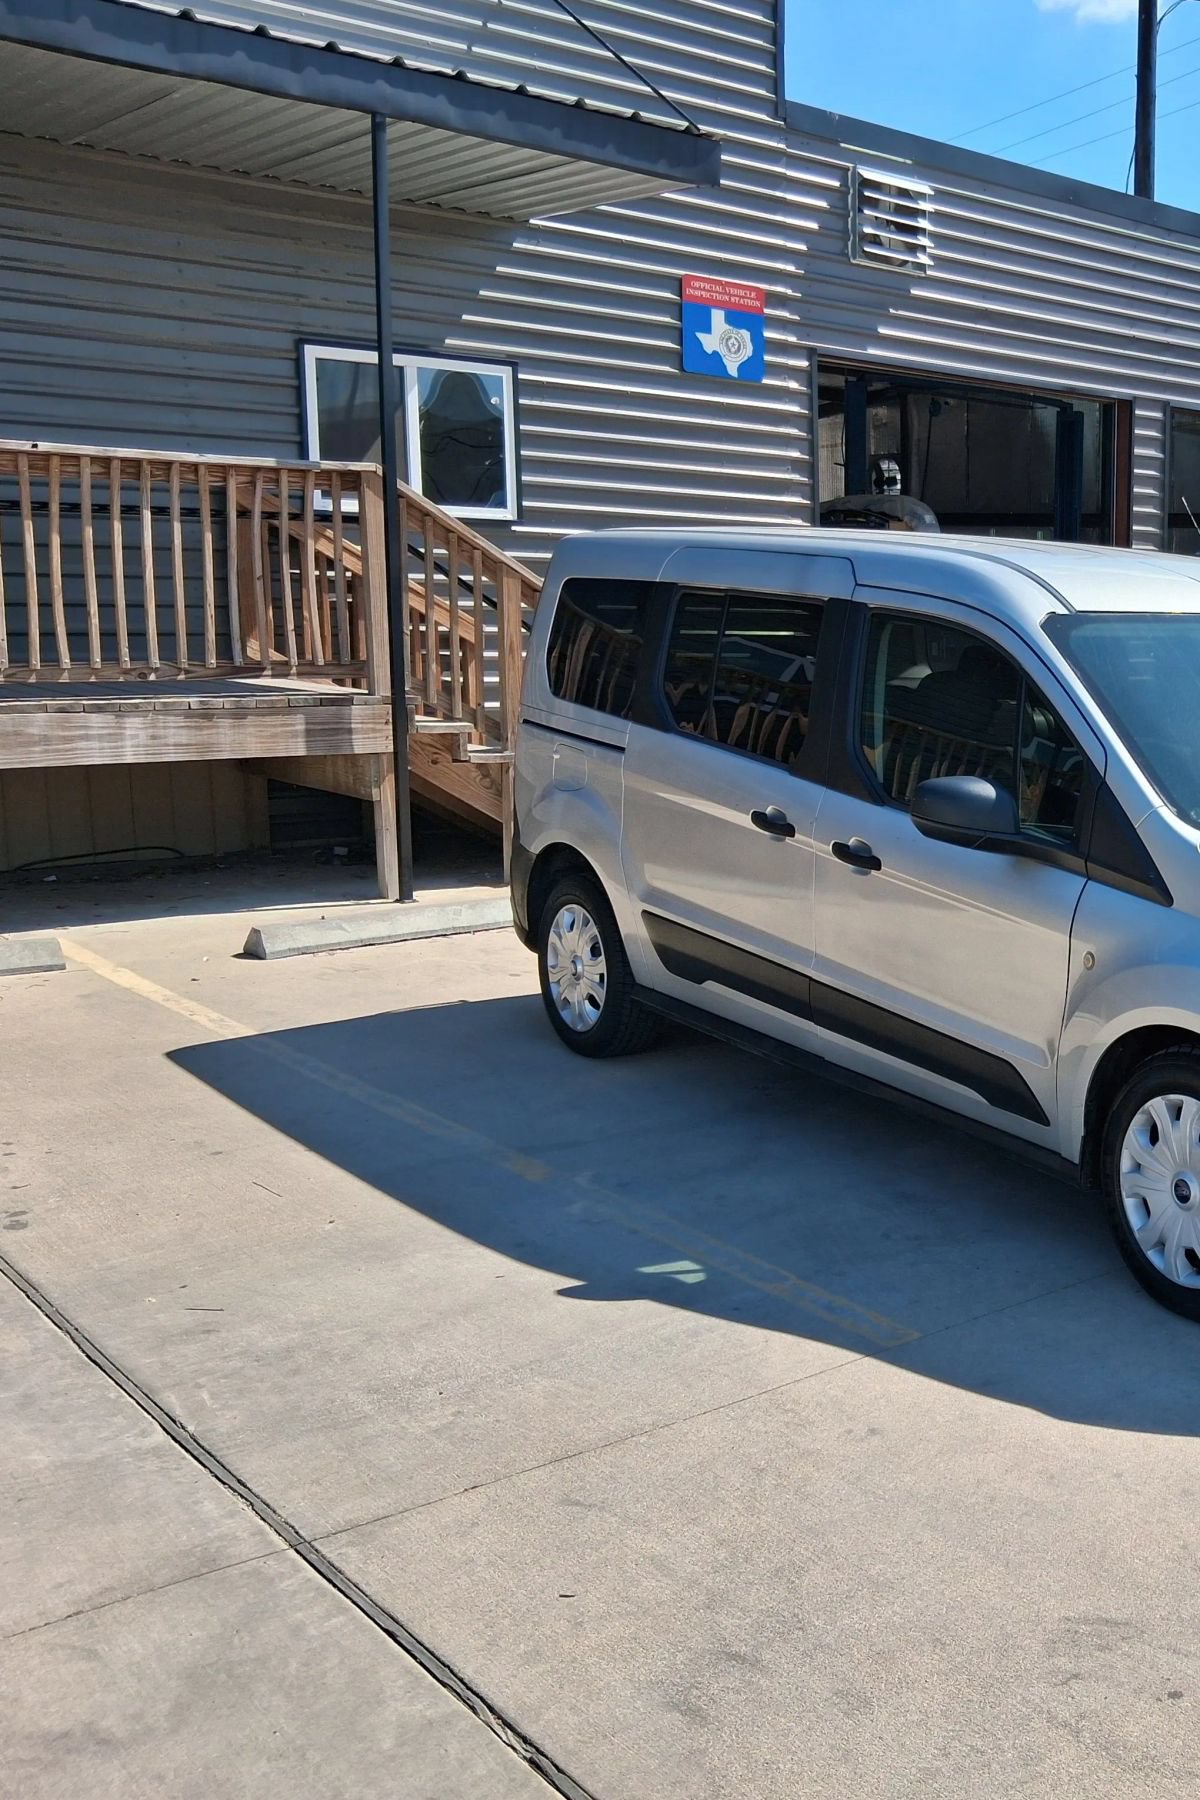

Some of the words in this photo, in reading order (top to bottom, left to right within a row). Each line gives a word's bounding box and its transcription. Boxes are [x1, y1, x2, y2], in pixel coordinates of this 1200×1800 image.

[686, 288, 730, 301] INSPECTION
[730, 297, 761, 307] STATION
[691, 281, 724, 293] OFFICIAL
[725, 286, 757, 298] VEHICLE
